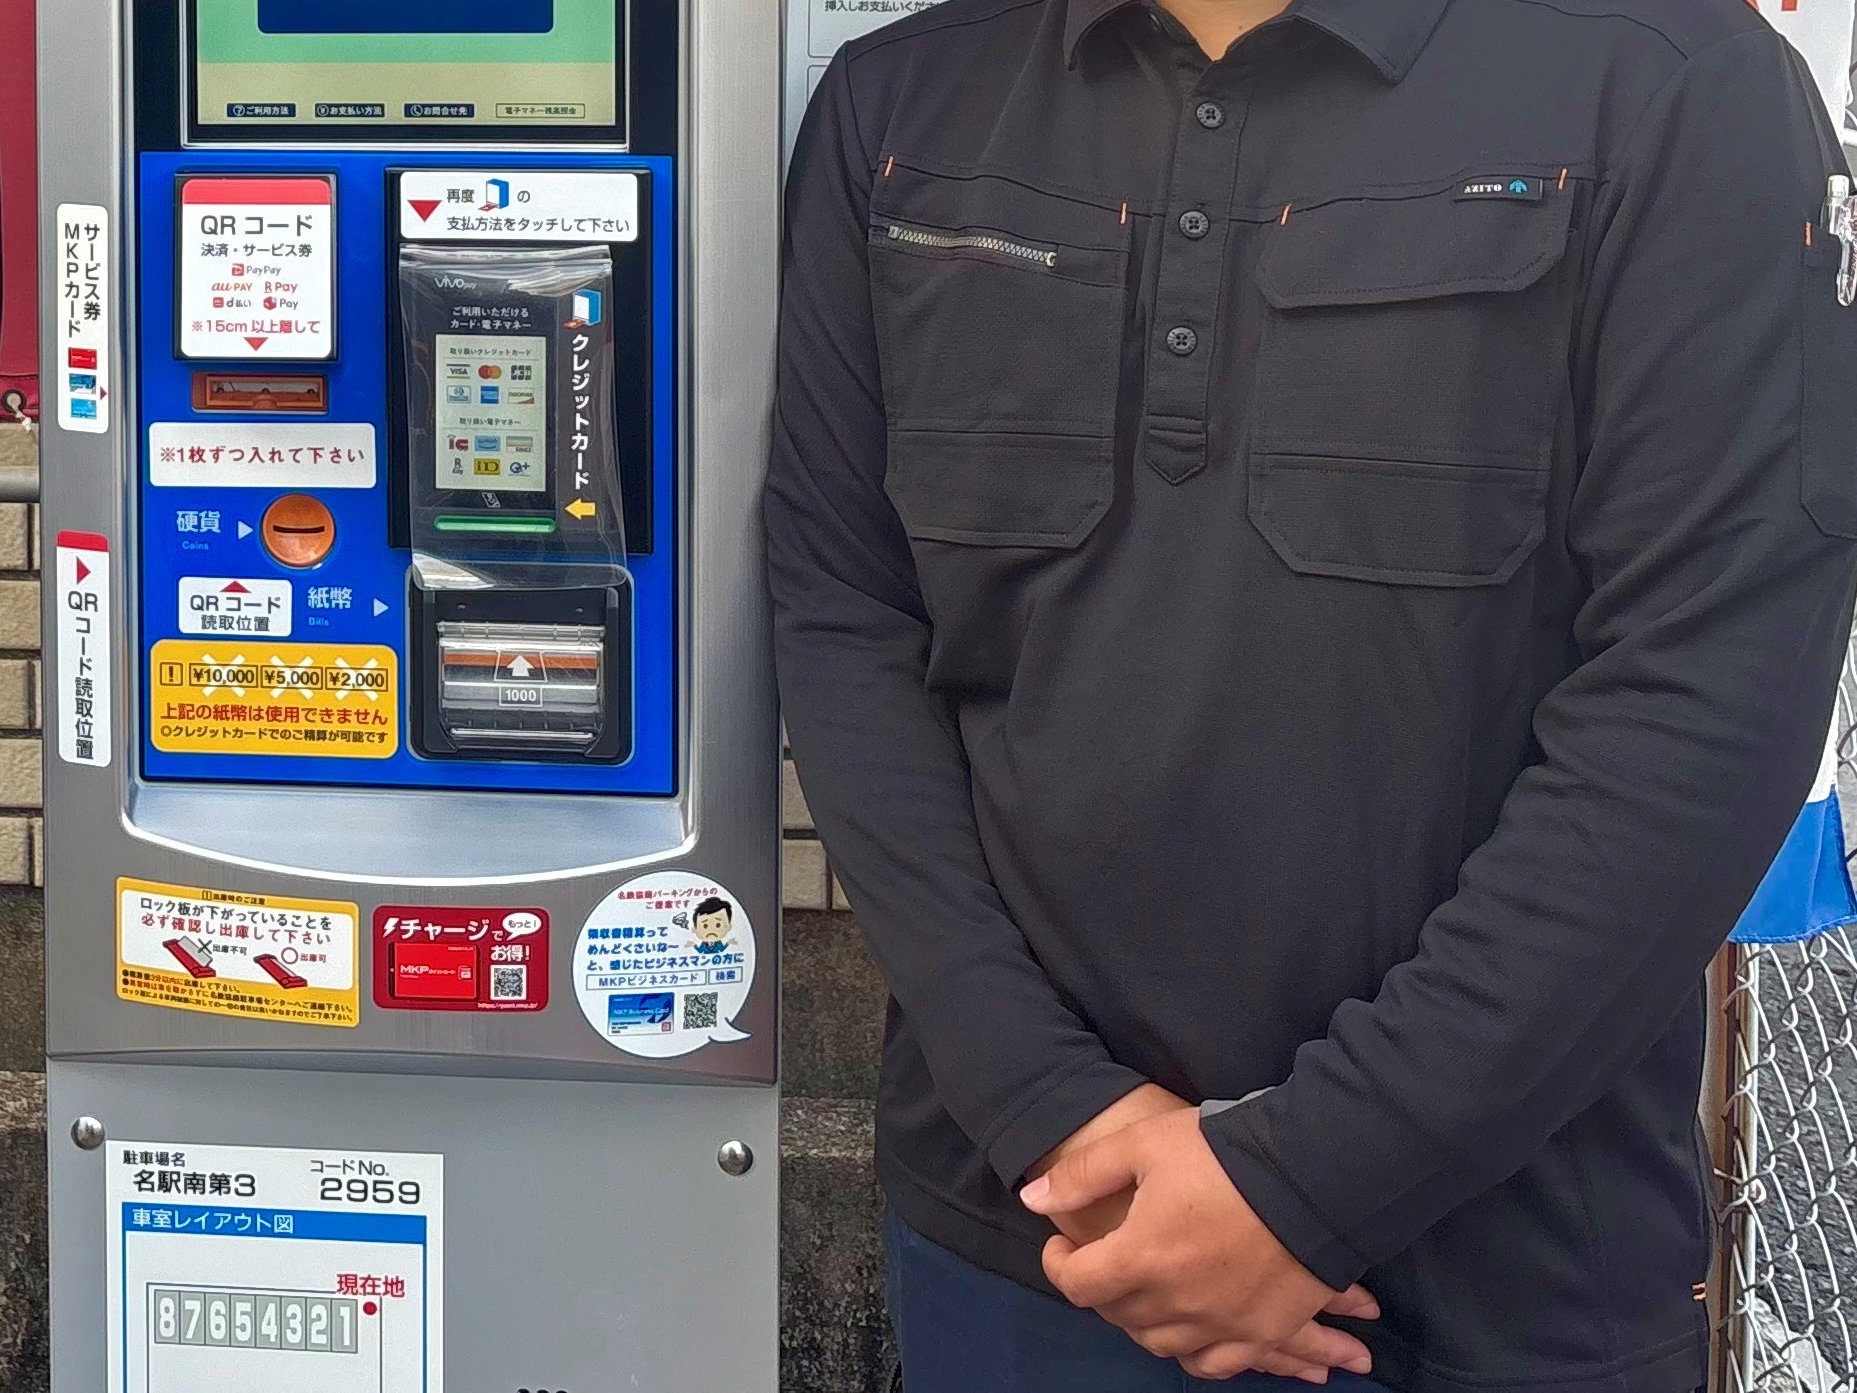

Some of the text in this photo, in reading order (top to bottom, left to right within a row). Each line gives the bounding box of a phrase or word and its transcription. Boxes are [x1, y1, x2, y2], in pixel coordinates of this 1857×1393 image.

[825, 0, 942, 12] 挿入しお支払いくだ
[447, 189, 531, 203] 再度 の
[1464, 183, 1503, 194] AZITO
[446, 217, 630, 233] 支払方法をタッチして下さい
[200, 243, 313, 258] 決済・サービス券
[84, 223, 101, 321] サービス券
[246, 265, 281, 277] PayPay
[64, 223, 81, 338] MKPカード
[274, 281, 298, 293] Pay
[279, 298, 299, 310] Pay
[452, 306, 529, 317] ご利用いただける
[450, 319, 532, 330] カード・電子マネー
[570, 334, 591, 491] クレジットカード
[176, 510, 221, 534] 硬貨
[181, 540, 209, 550] Coins
[307, 586, 353, 610] 紙幣
[200, 614, 271, 632] 読取位置
[308, 617, 329, 626] Bills
[193, 668, 385, 687] ¥10,000 ¥5,000 ¥2,000
[505, 689, 537, 702] 1000
[160, 702, 389, 725] 上記の紙幣は使用できません
[140, 897, 332, 930] ロック板が下がっていることを
[141, 912, 332, 945] 必ず確認し出庫して下さい
[123, 1150, 186, 1167] 駐車場名
[132, 1169, 257, 1197] 名駅南第3
[319, 1177, 421, 1204] 2959
[132, 1209, 294, 1234] 車室レイアウト図
[336, 1273, 406, 1299] 現在地
